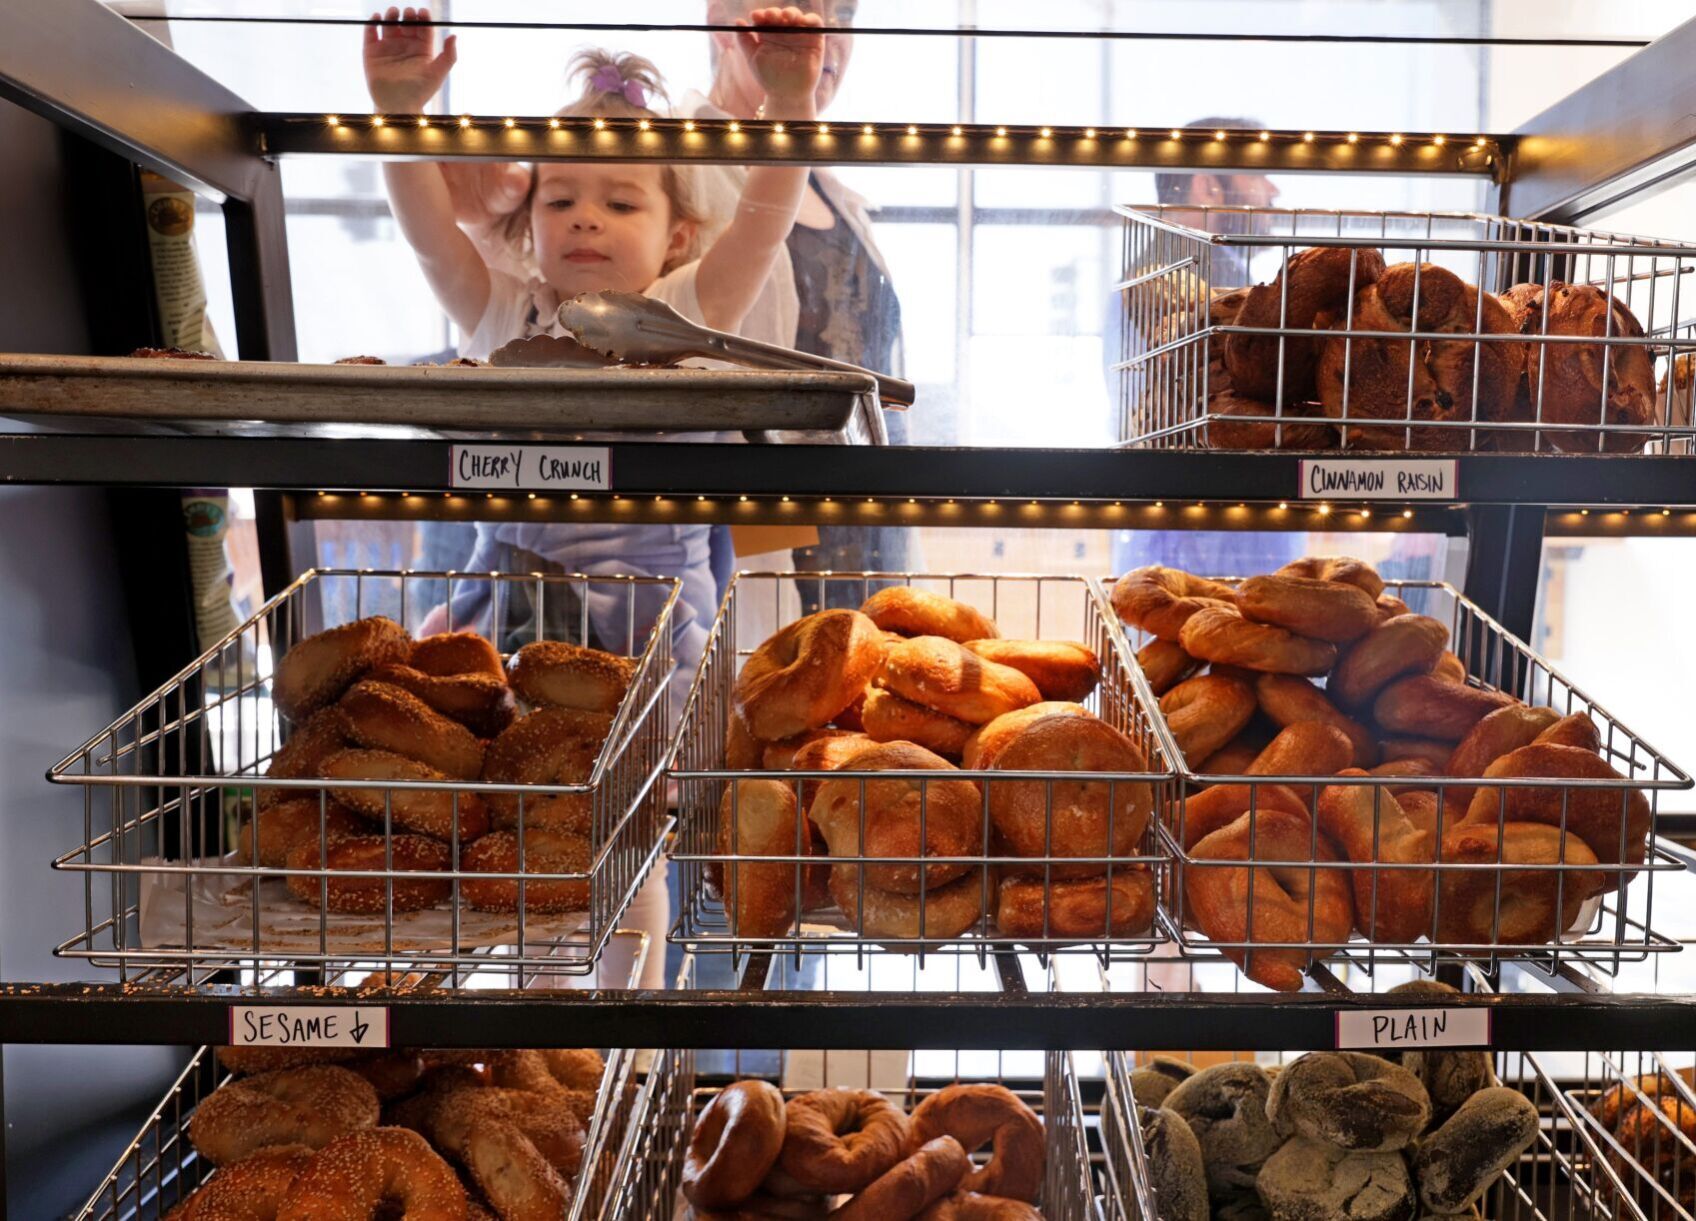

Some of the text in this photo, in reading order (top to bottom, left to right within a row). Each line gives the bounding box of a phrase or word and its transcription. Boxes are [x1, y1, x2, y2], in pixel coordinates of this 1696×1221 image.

[459, 449, 601, 487] CHERRY CRUNCH
[1311, 465, 1443, 493] CINNAMON RAISIN
[244, 1010, 338, 1043] SESAME
[1372, 1010, 1446, 1043] PLAIN
